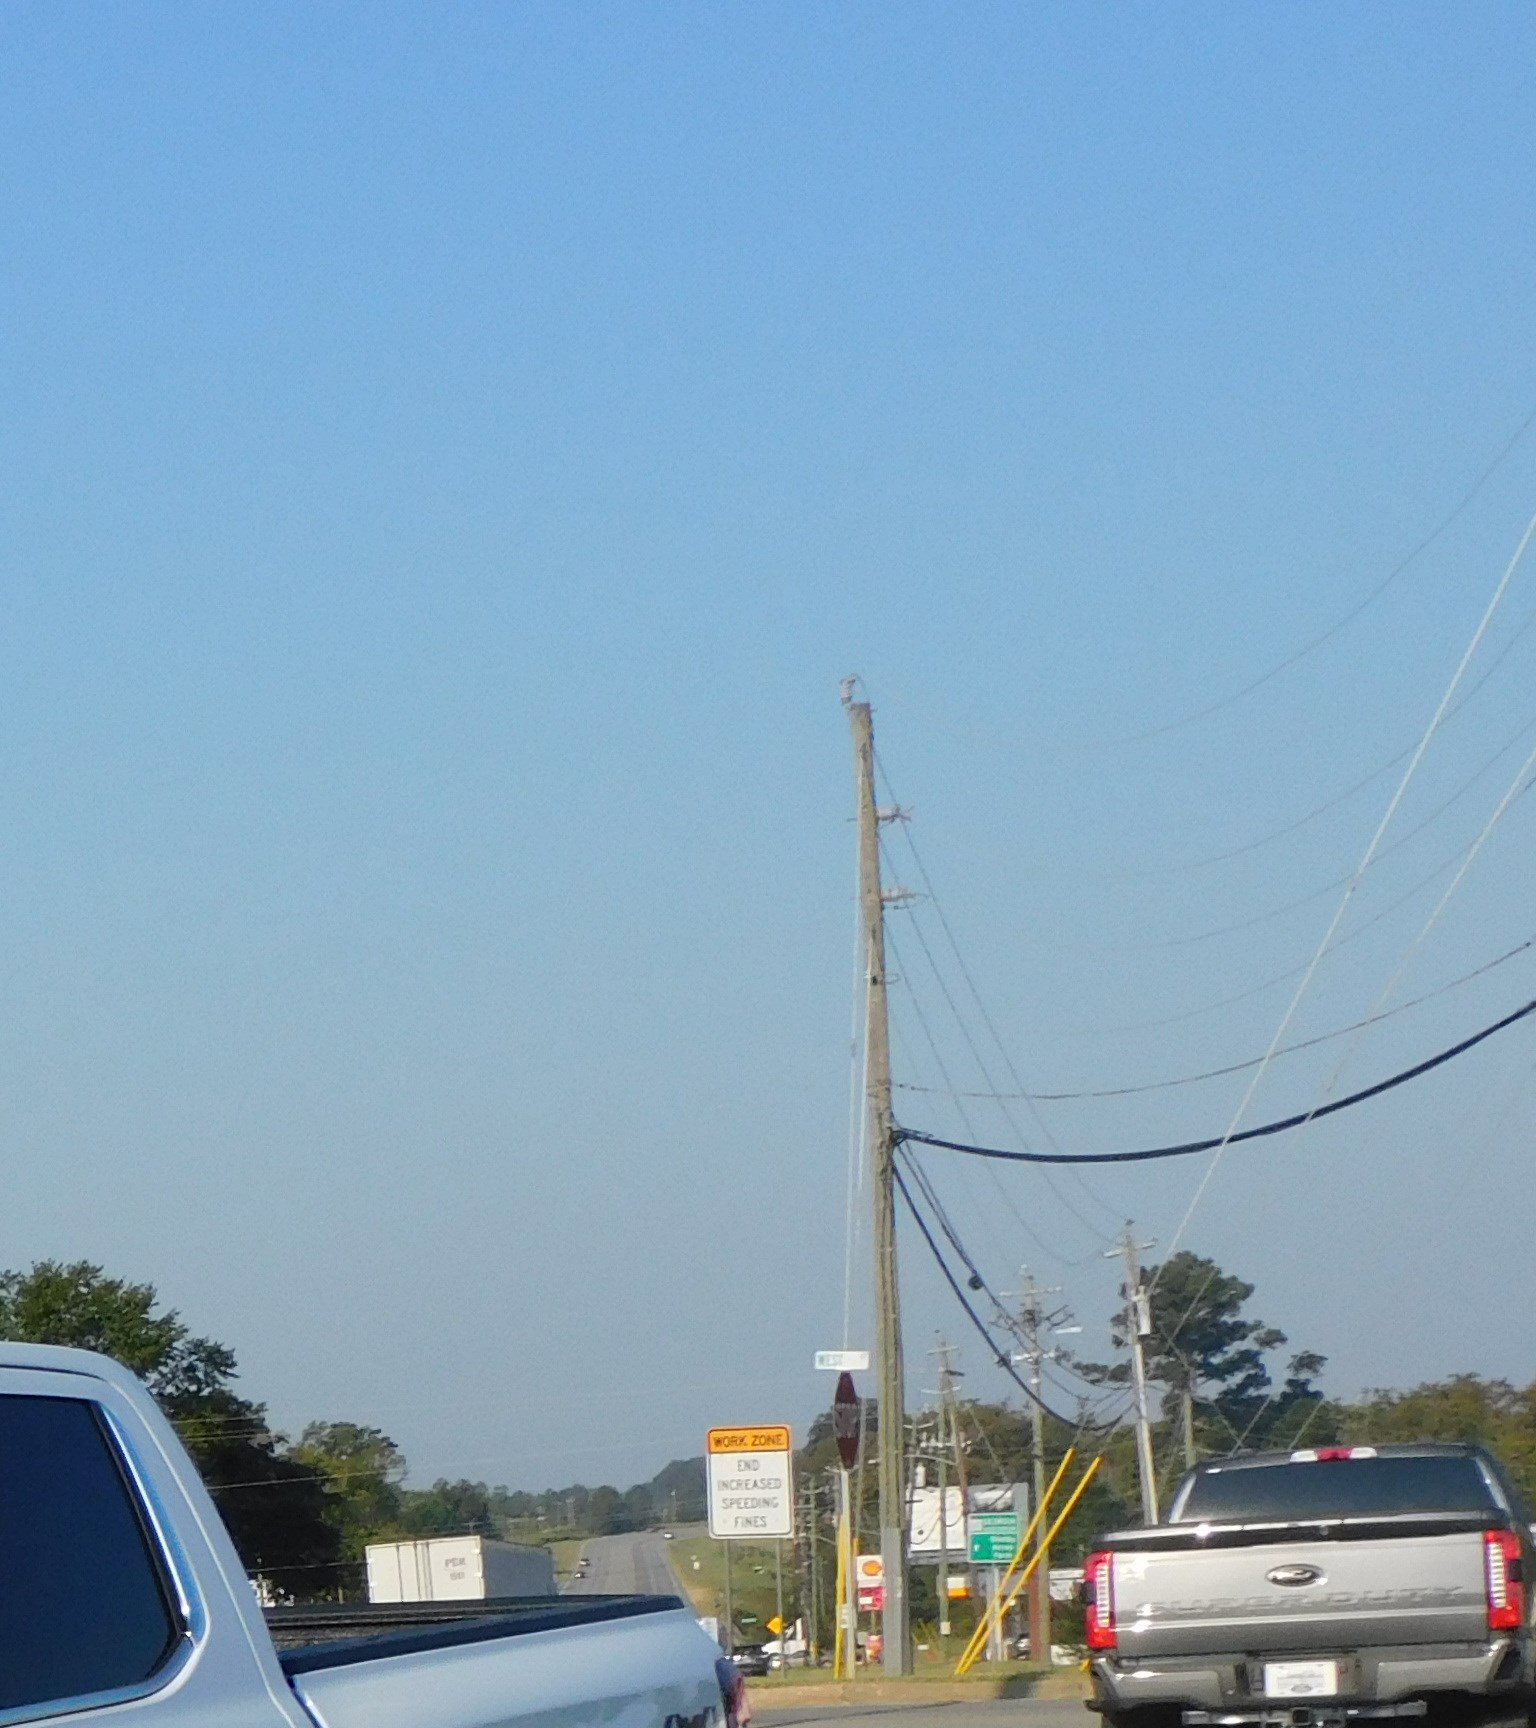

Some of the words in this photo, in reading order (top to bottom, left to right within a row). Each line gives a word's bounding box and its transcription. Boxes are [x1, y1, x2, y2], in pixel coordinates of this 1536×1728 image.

[714, 1435, 747, 1448] WORK
[751, 1433, 784, 1447] ZONE
[737, 1459, 760, 1472] END
[718, 1478, 782, 1491] INCREASED
[721, 1497, 779, 1509] SPEEDING
[734, 1516, 767, 1528] FINES
